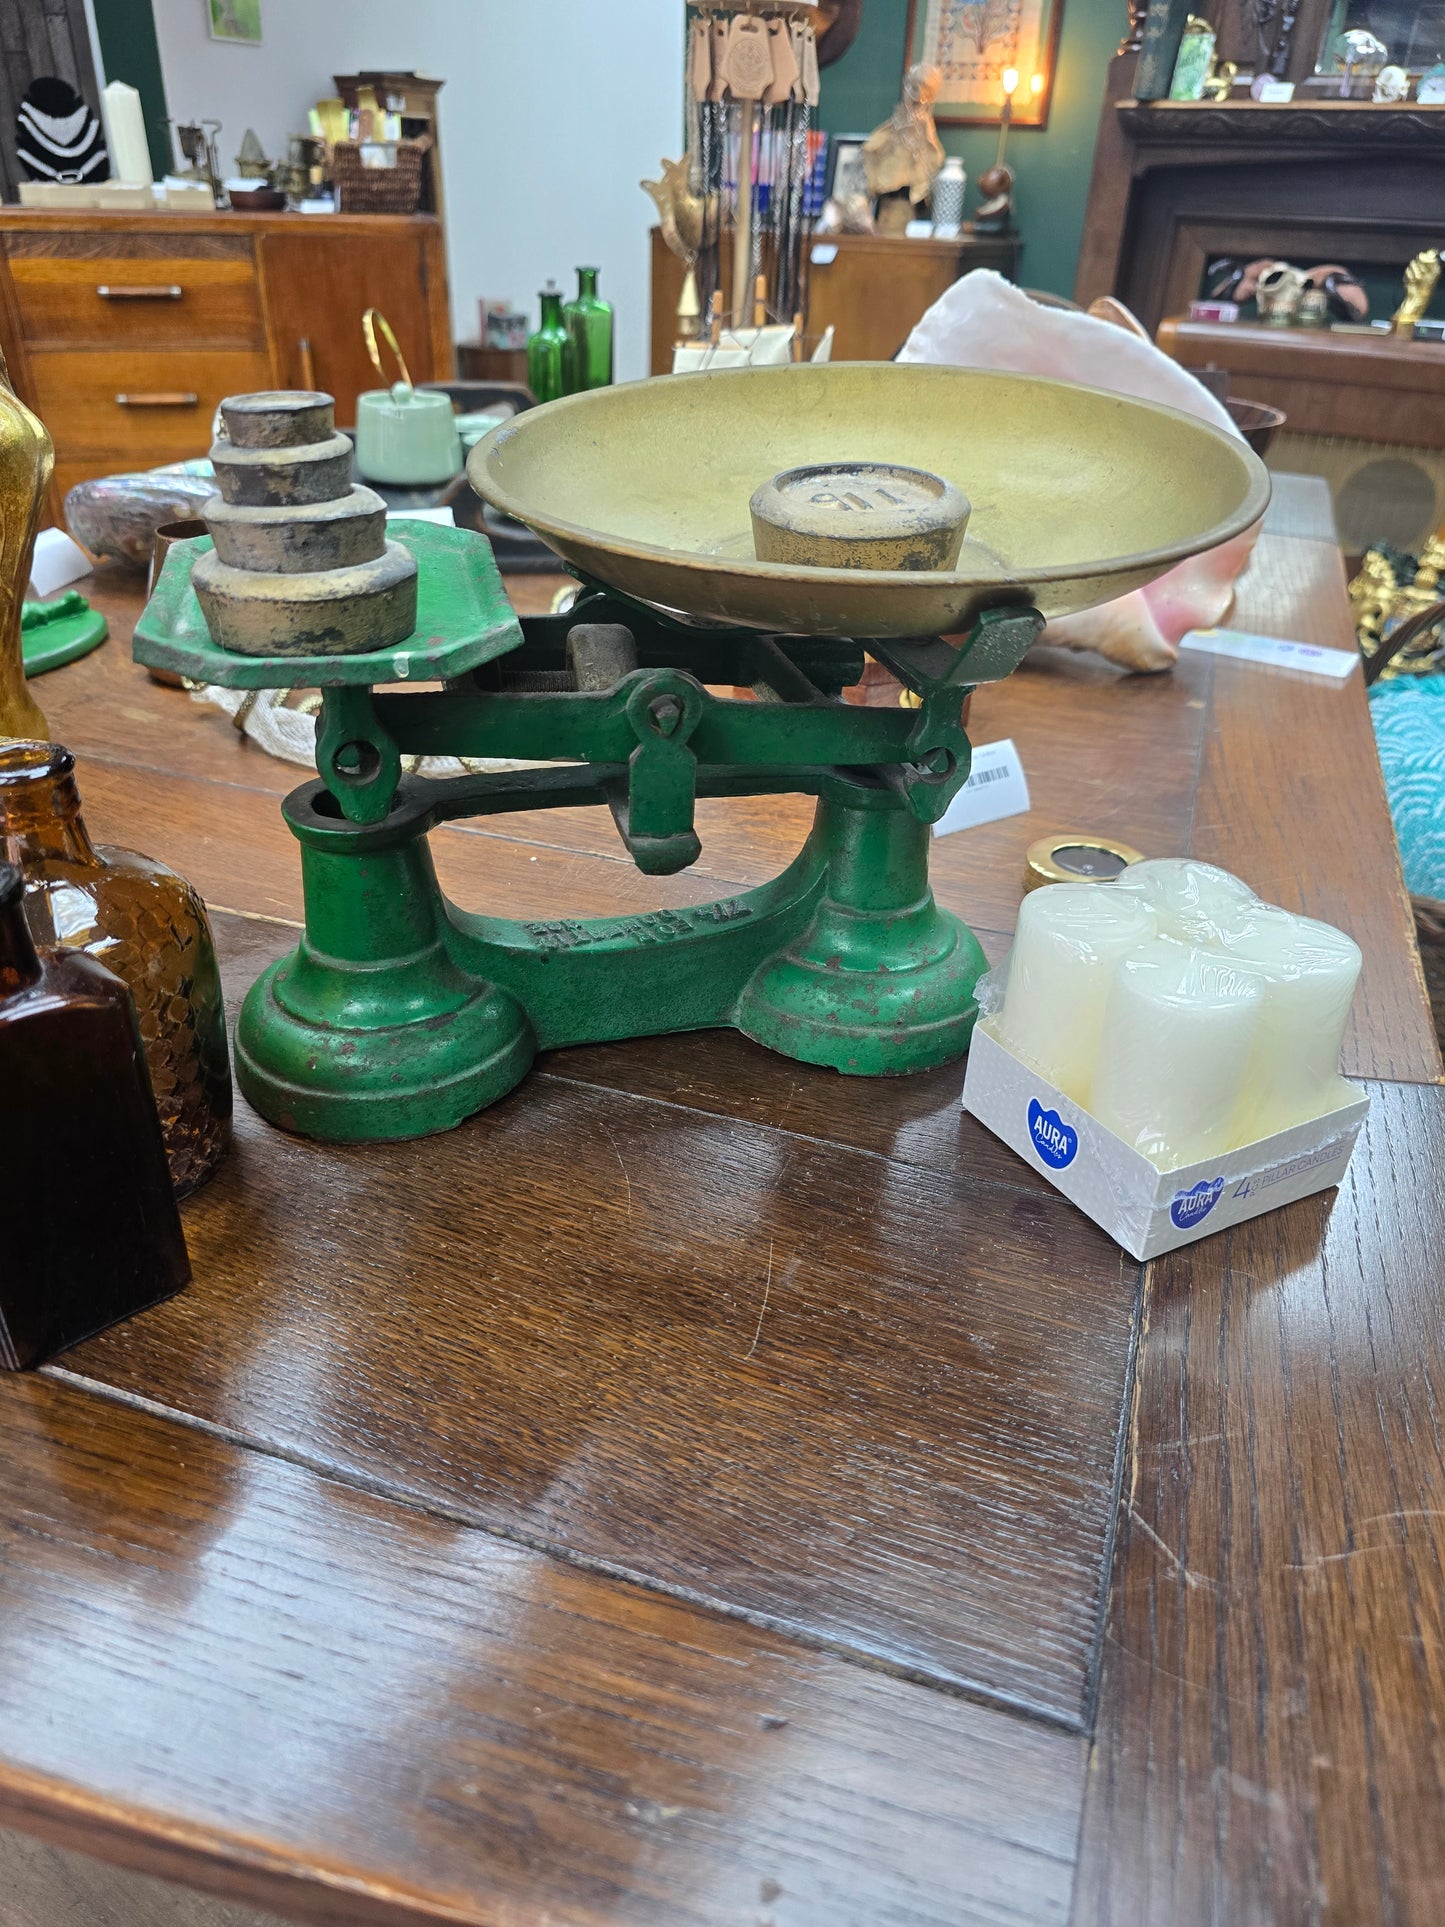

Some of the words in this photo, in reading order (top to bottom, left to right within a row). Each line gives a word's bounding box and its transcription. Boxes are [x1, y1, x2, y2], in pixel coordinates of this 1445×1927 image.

[1034, 1115, 1067, 1155] AURA
[1232, 1177, 1251, 1199] 4
[1262, 1166, 1297, 1186] PILLAR
[1298, 1146, 1344, 1171] CANDLES
[1178, 1193, 1213, 1215] AURA
